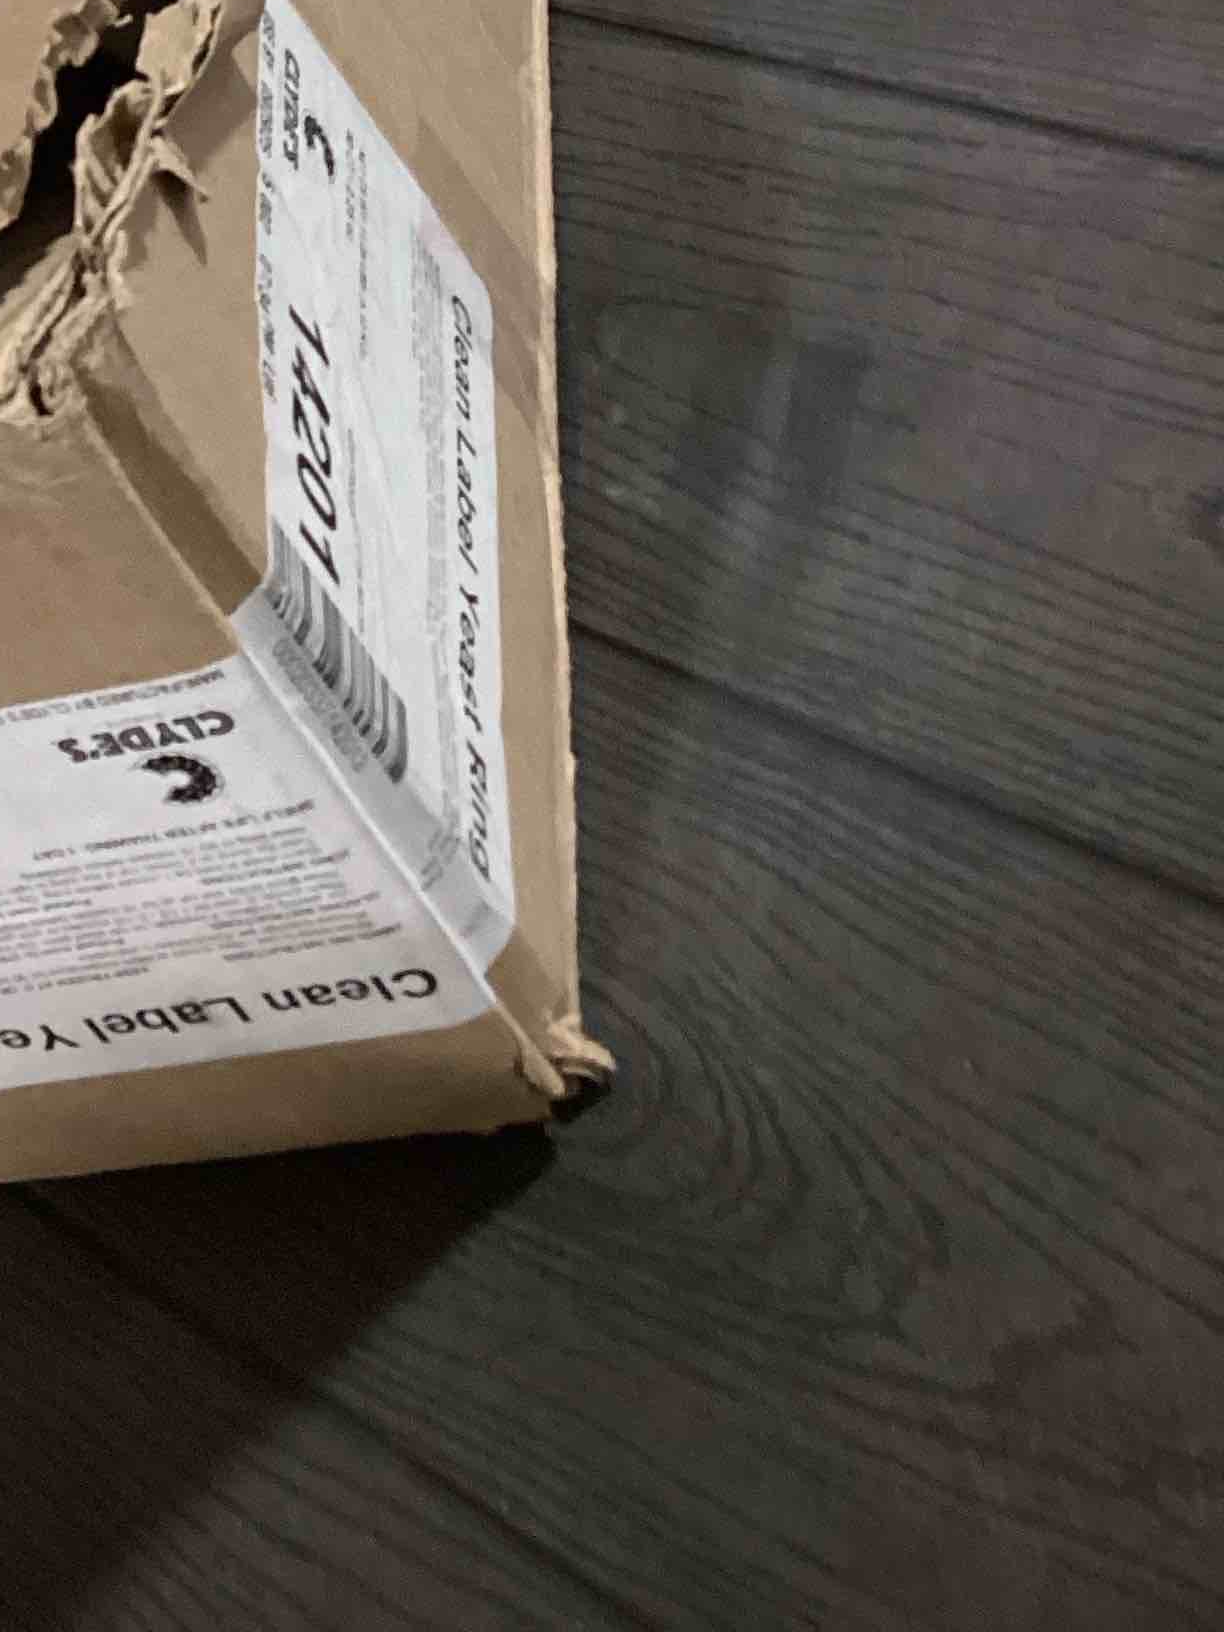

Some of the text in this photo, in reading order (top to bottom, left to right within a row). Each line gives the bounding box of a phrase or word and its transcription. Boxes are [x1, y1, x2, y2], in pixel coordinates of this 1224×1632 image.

[289, 303, 340, 585] 14201
[451, 295, 492, 881] Clean Label Yeast Ring
[56, 709, 236, 764] CLYDE'S
[259, 967, 440, 1011] Clean
[82, 996, 250, 1044] Label
